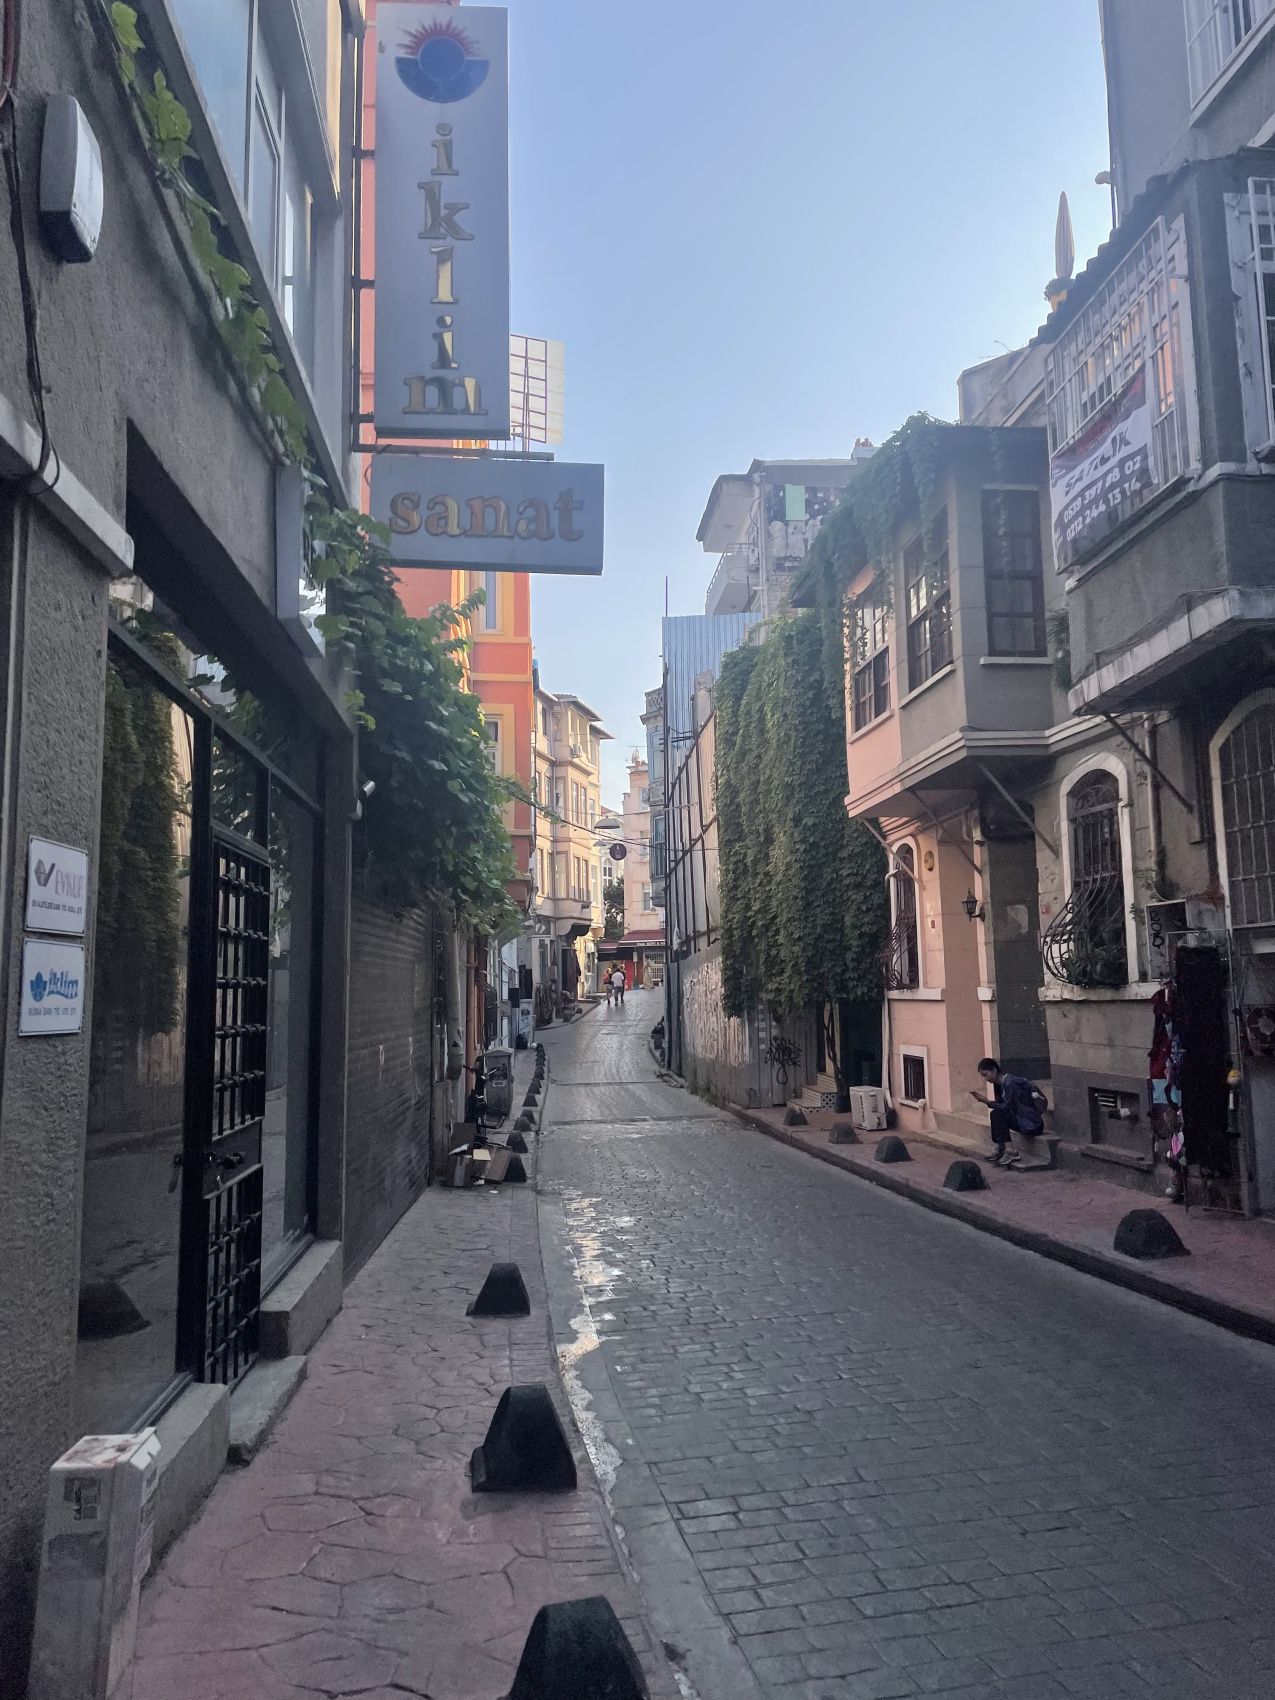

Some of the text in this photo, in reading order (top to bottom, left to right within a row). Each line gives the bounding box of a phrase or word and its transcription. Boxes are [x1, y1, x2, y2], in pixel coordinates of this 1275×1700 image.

[402, 123, 488, 416] iklim
[1124, 455, 1141, 475] 02
[389, 487, 584, 542] sanat
[1066, 516, 1083, 542] 0212
[1084, 499, 1106, 525] 244
[1108, 488, 1121, 507] 13
[1124, 477, 1141, 497] 14
